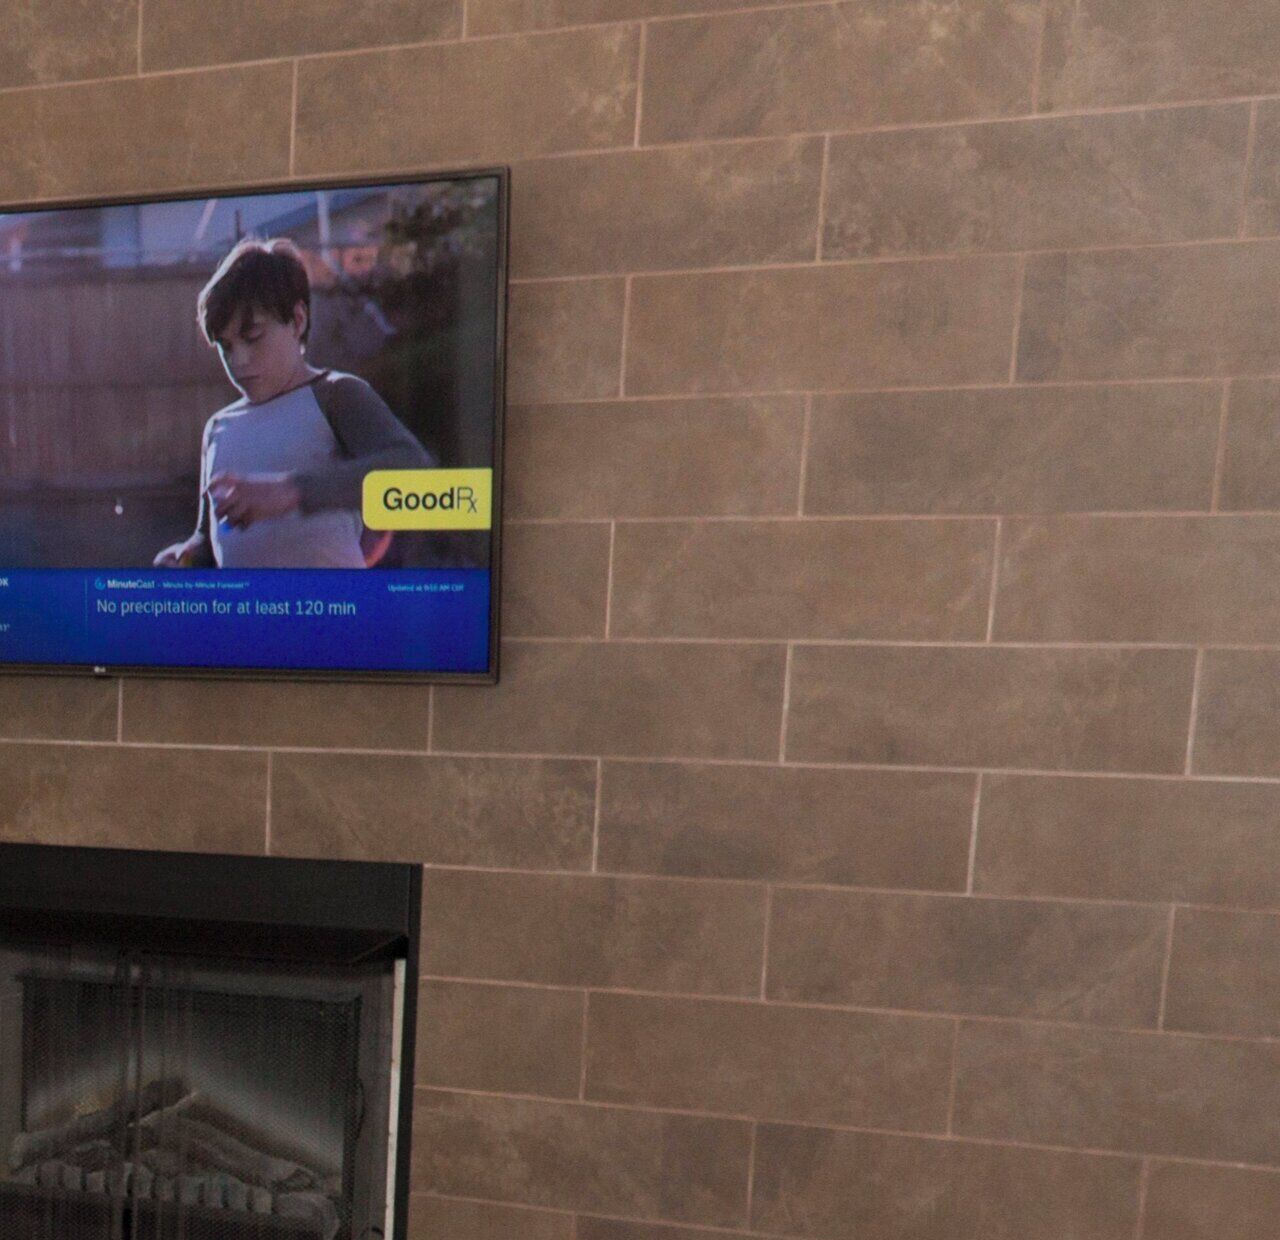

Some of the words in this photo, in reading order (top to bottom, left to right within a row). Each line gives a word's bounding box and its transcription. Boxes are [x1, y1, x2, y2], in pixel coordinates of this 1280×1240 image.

[107, 579, 155, 589] MinuteCast
[96, 600, 117, 613] No
[121, 599, 208, 617] precipitation
[212, 599, 232, 613] for
[237, 601, 250, 615] at
[255, 599, 290, 615] least
[296, 600, 324, 615] 120
[328, 601, 356, 615] min
